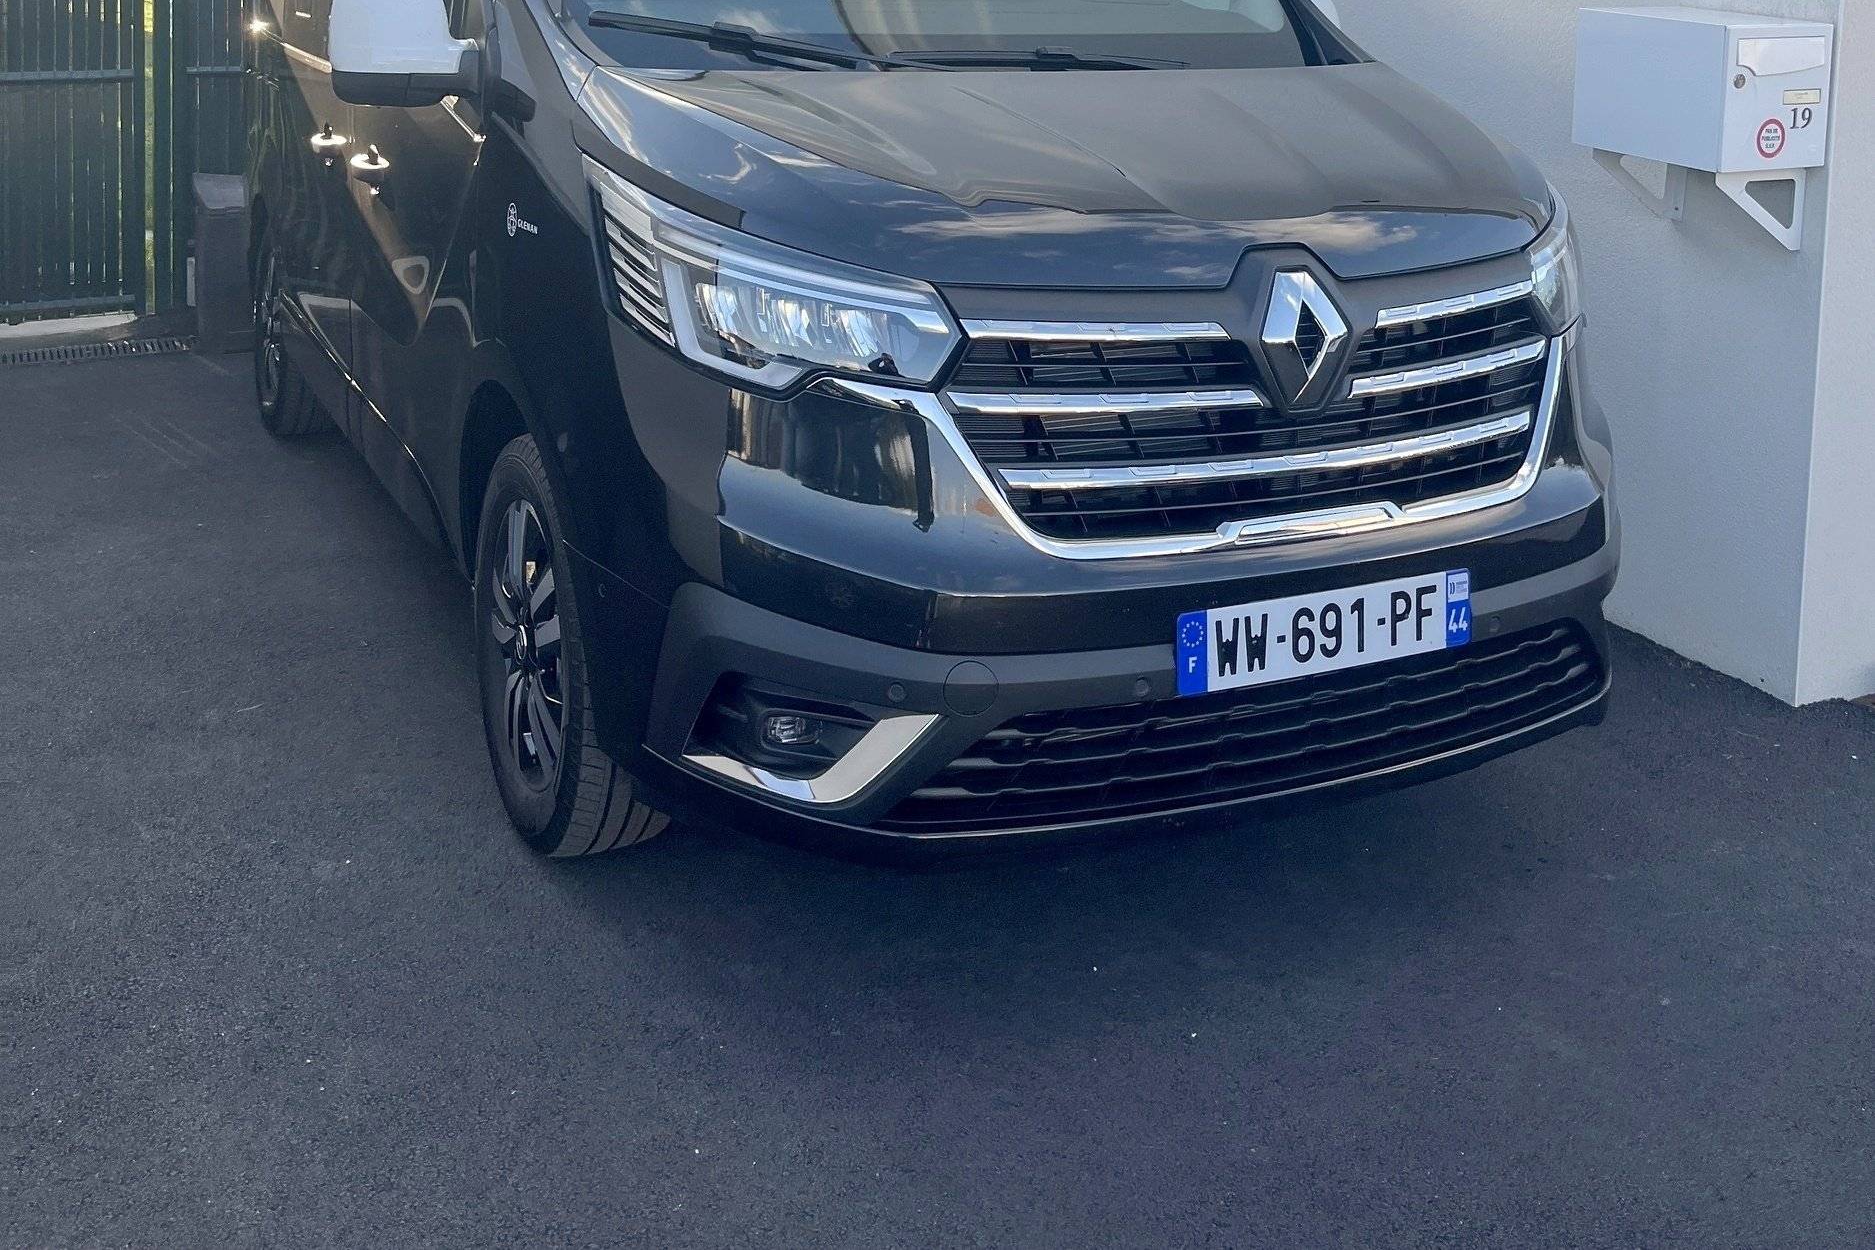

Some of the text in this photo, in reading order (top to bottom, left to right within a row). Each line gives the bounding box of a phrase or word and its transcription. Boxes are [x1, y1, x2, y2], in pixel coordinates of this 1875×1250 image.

[1790, 107, 1813, 129] 19
[1215, 584, 1437, 677] WW-691-PF
[1448, 606, 1468, 633] 44
[1188, 656, 1198, 674] F
